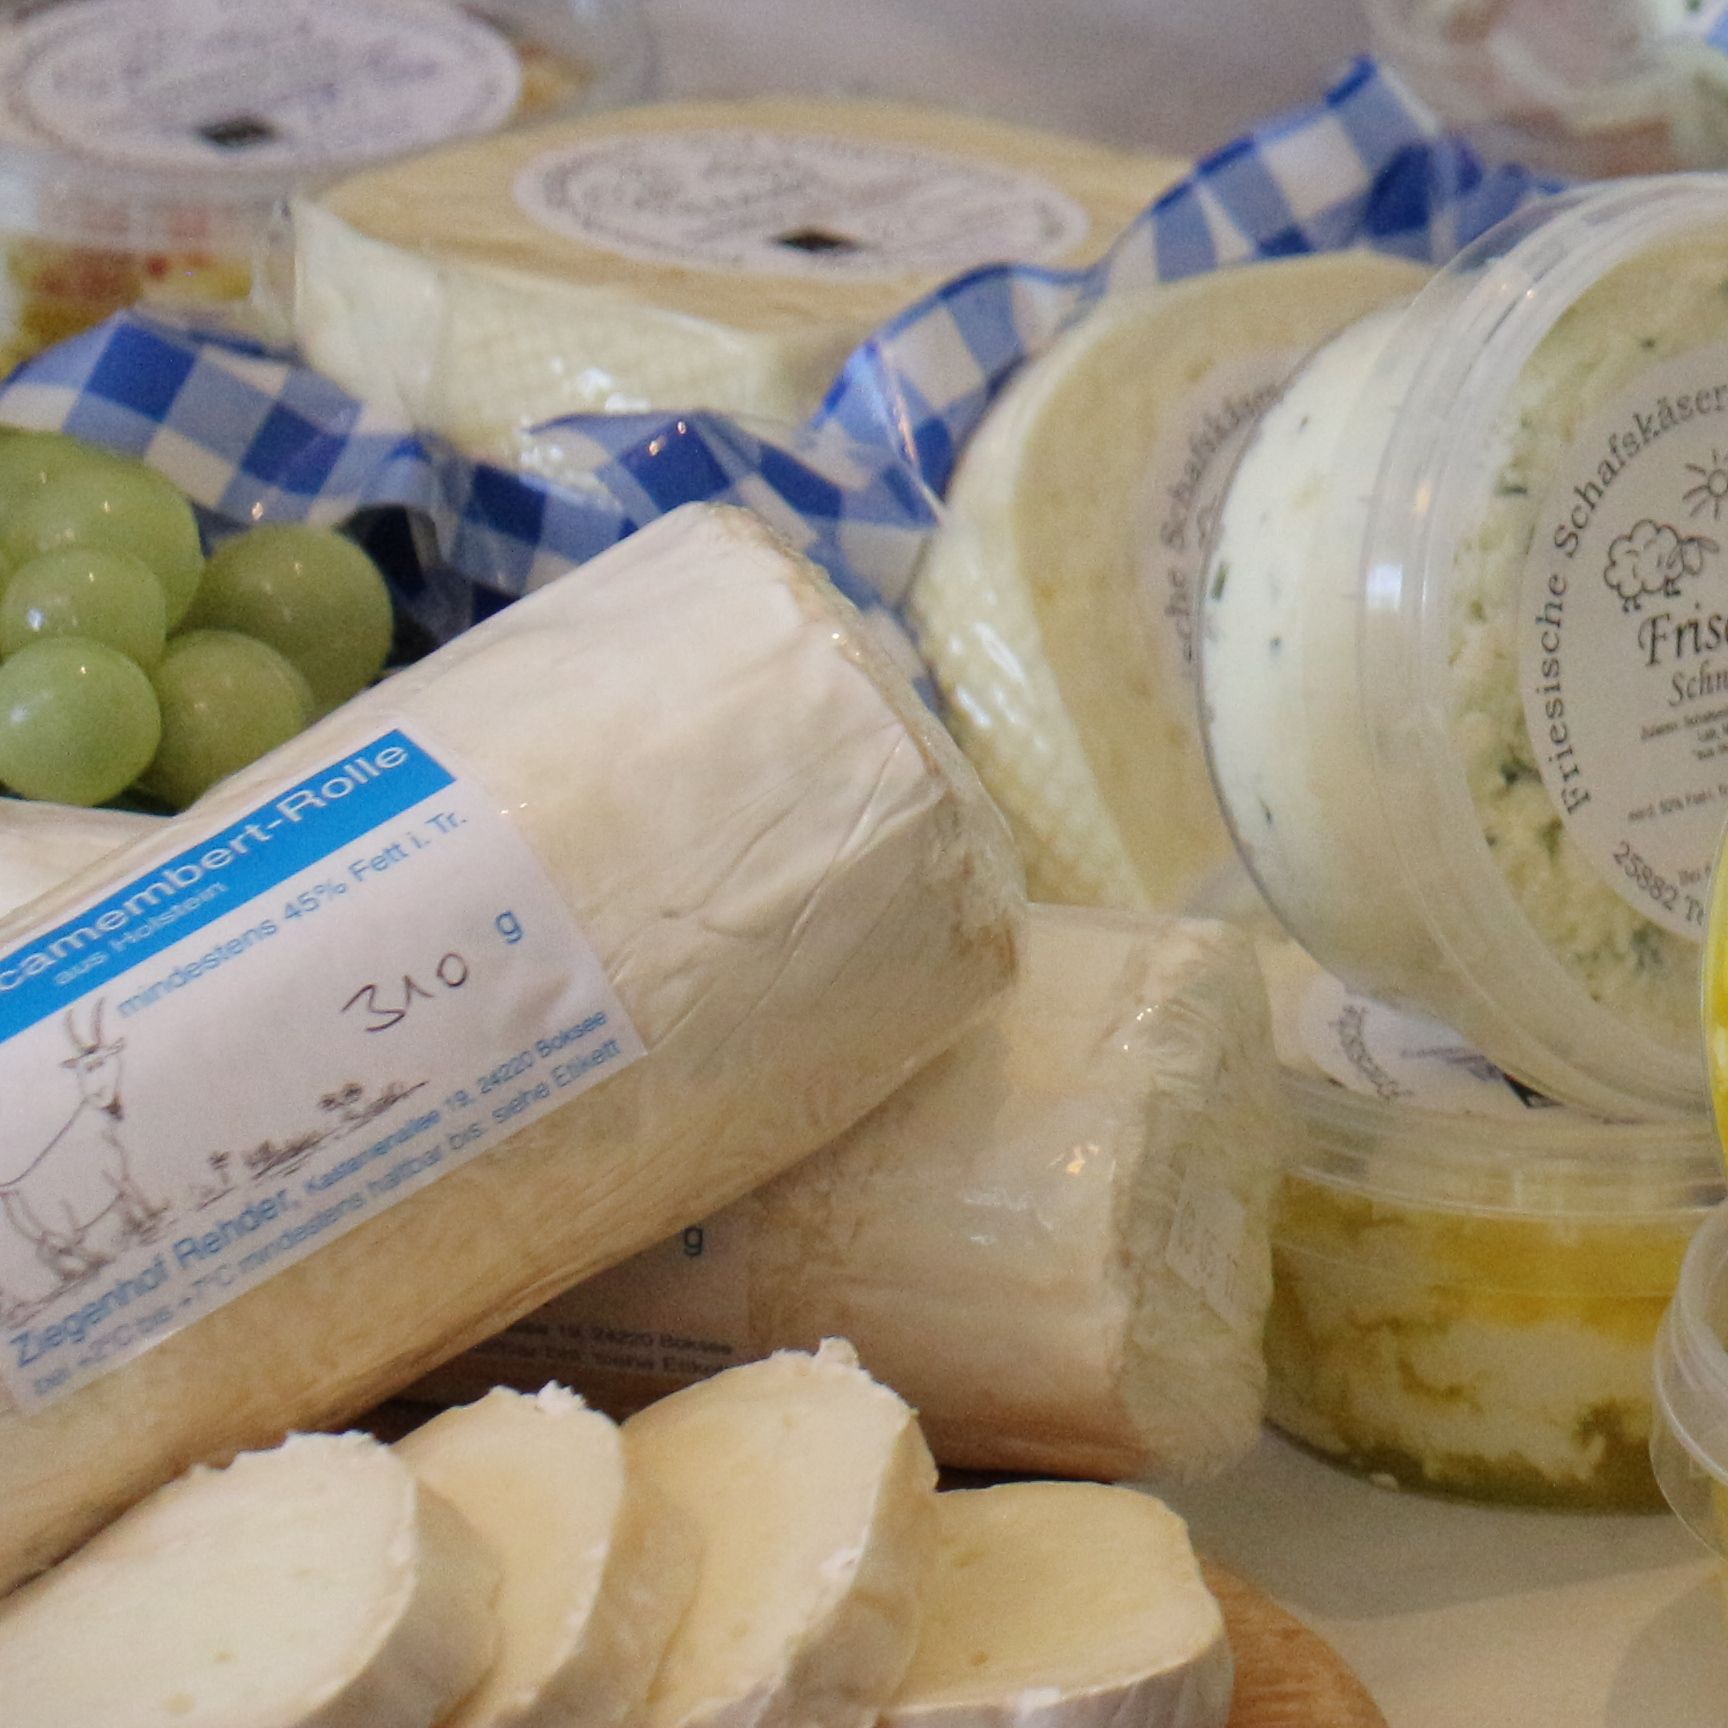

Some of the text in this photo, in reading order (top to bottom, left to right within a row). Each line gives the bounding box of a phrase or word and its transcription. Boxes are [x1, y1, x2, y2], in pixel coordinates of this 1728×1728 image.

[1535, 572, 1593, 815] Friesische
[116, 918, 279, 1018] mindestens
[284, 880, 349, 920] 45%
[348, 842, 407, 883] Fett
[426, 809, 468, 834] Tr.
[1612, 841, 1679, 912] 25882
[494, 909, 523, 945] g
[340, 951, 469, 1032] 310
[491, 1082, 551, 1124] siehe
[552, 1039, 621, 1088] Etikett
[9, 1251, 169, 1369] Ziegenhof
[535, 1010, 608, 1058] Boksee
[684, 1226, 703, 1256] g
